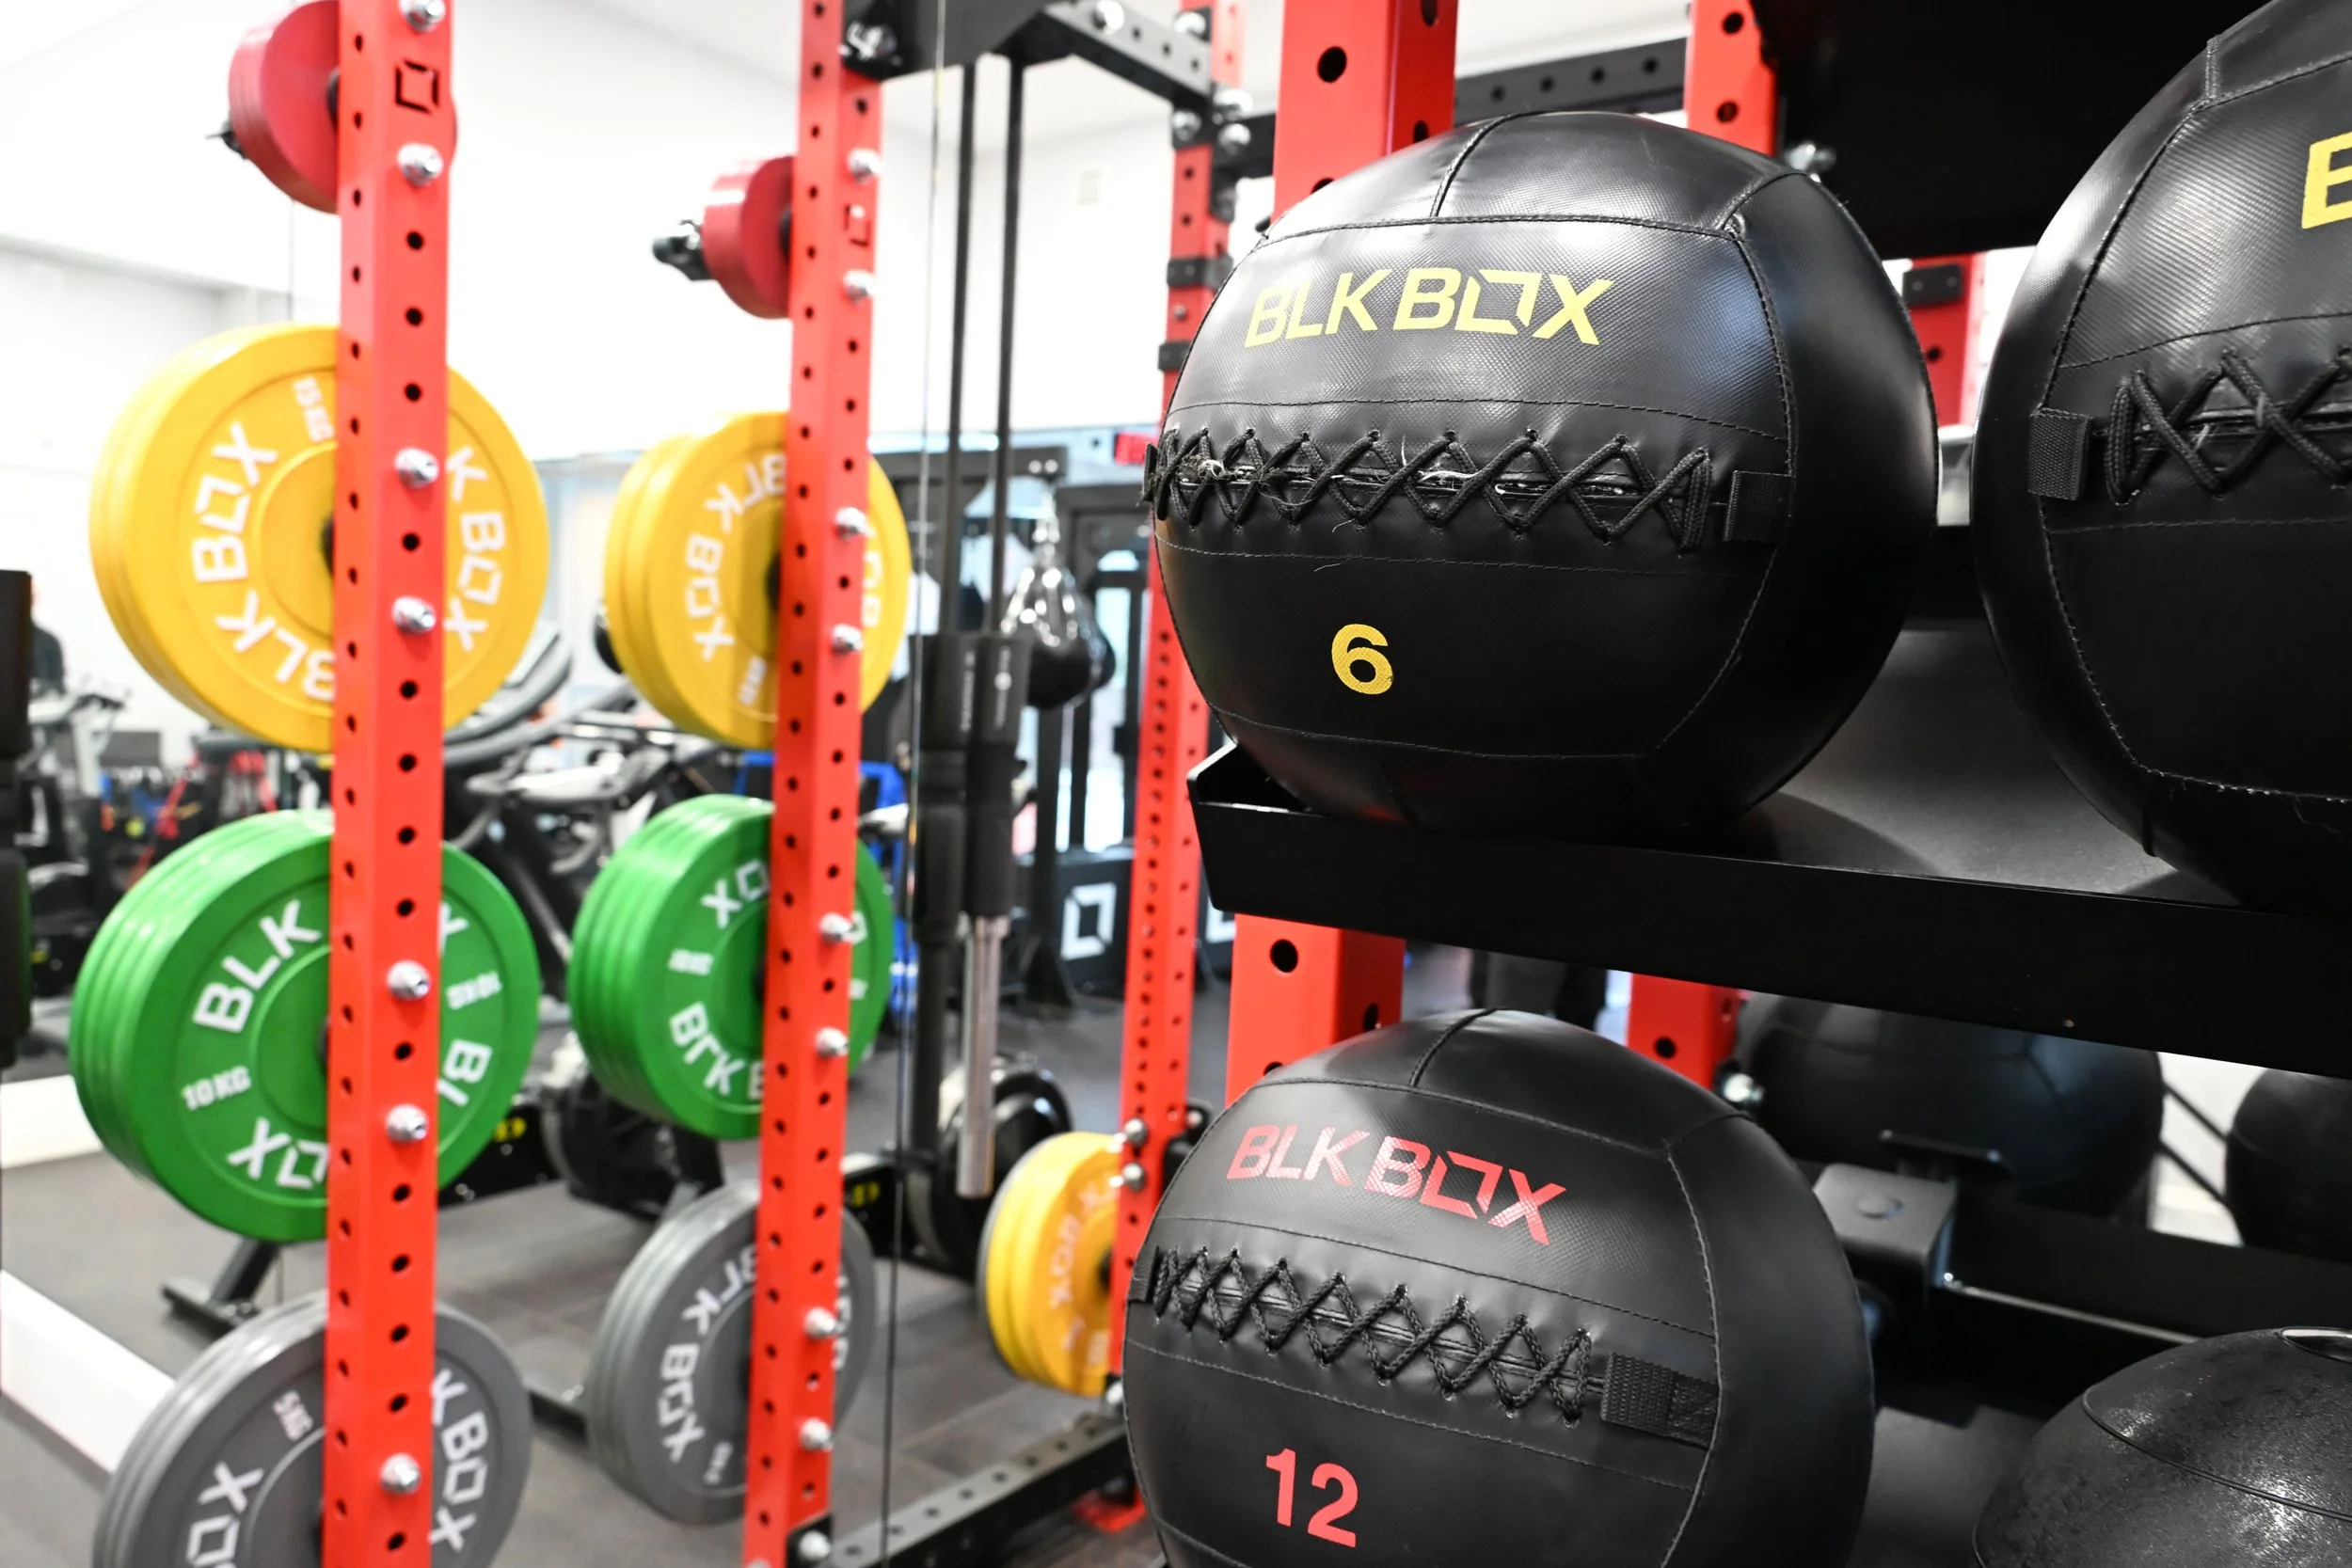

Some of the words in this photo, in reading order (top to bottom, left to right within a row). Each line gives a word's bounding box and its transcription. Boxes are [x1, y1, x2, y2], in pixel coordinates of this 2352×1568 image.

[1244, 269, 1393, 349] BLK
[1391, 267, 1615, 346] BOX
[191, 421, 278, 583] BOX
[444, 511, 506, 653] BOX
[1330, 623, 1394, 695] 6
[192, 899, 322, 1033] BLK
[1226, 1125, 1371, 1187] BLK
[1364, 1135, 1567, 1245] BOX
[186, 1461, 265, 1568] OX
[428, 1411, 489, 1553] BOX
[1265, 1448, 1359, 1548] 12
